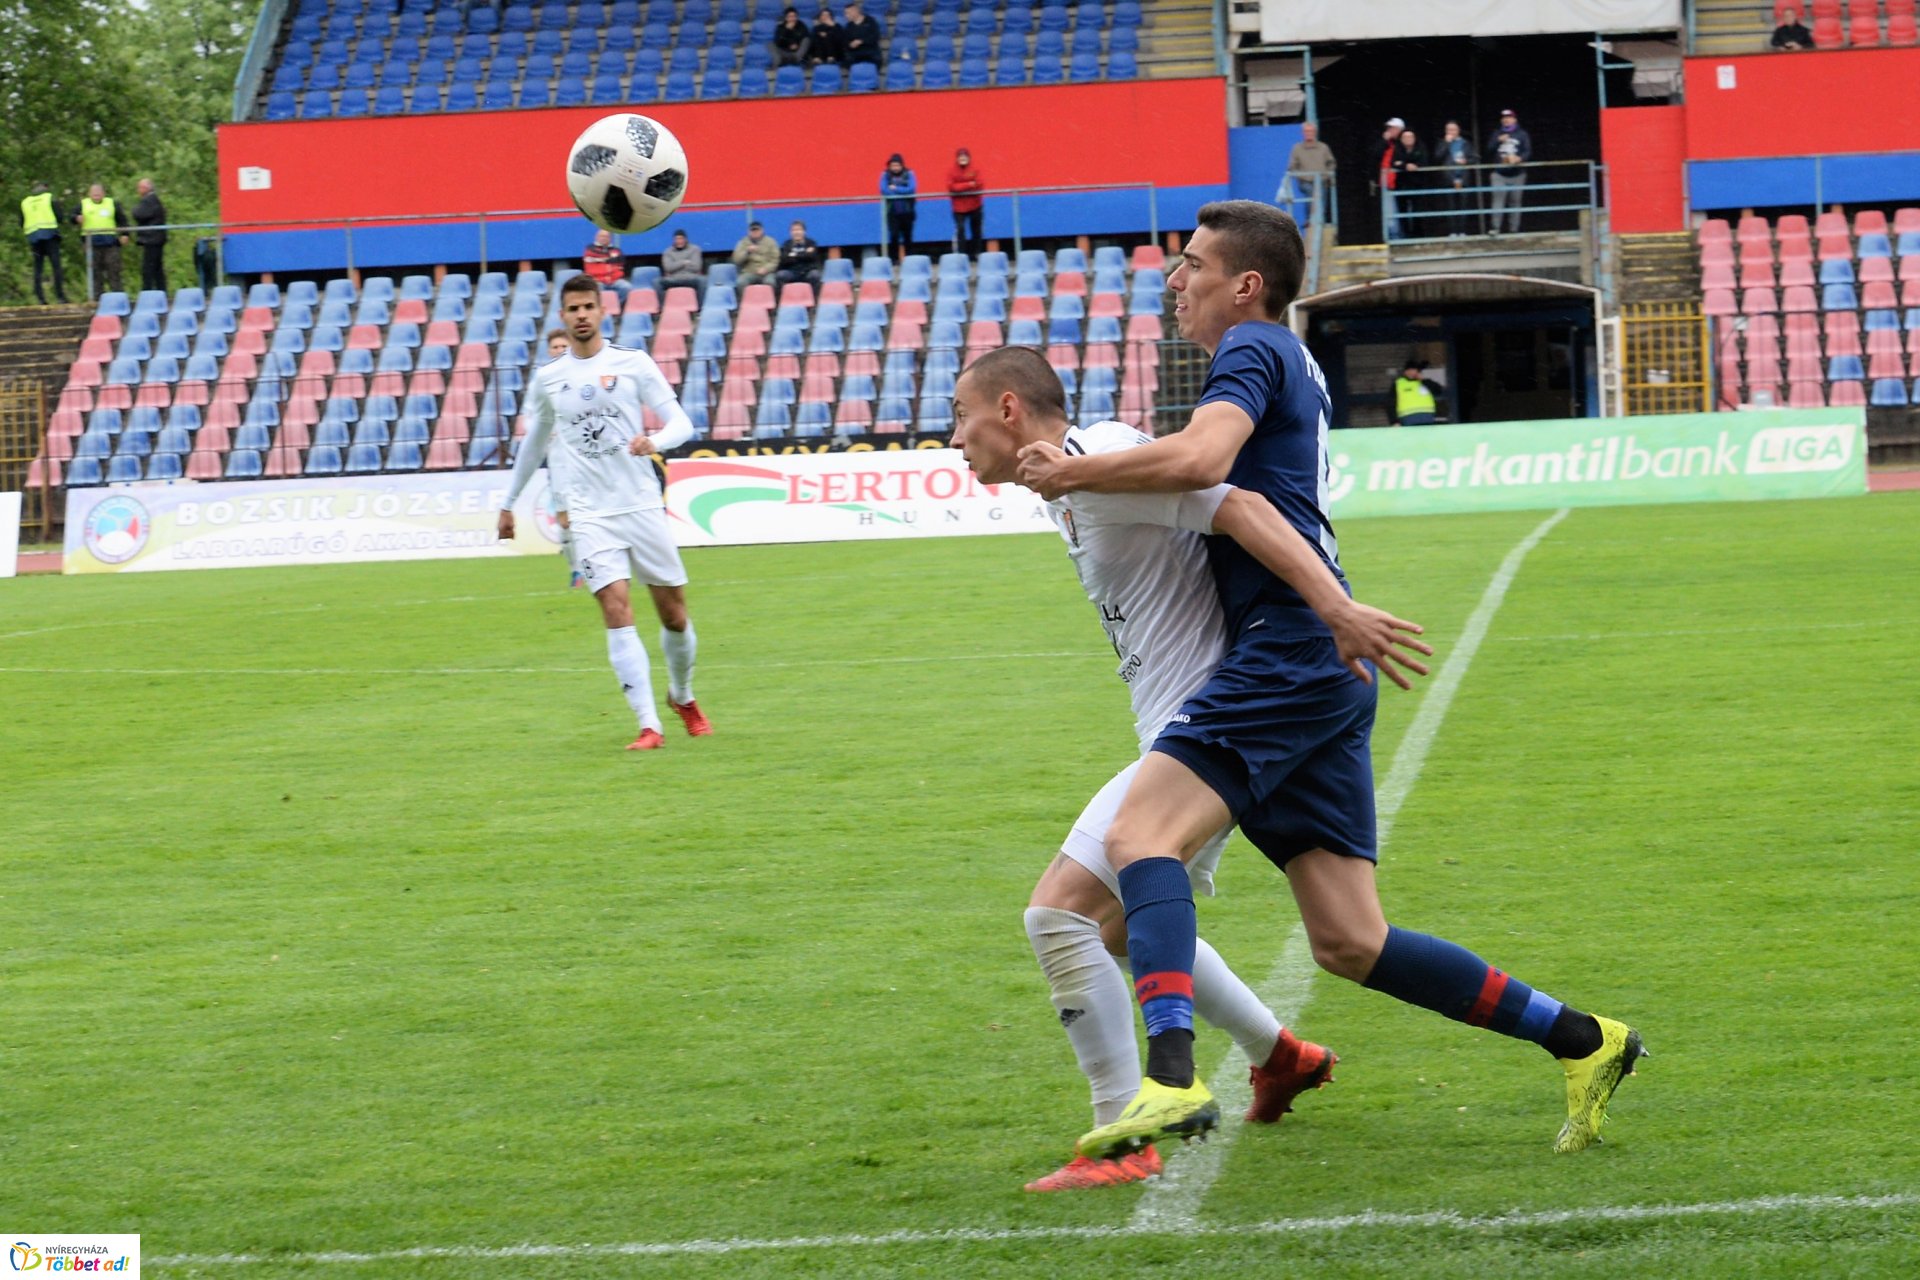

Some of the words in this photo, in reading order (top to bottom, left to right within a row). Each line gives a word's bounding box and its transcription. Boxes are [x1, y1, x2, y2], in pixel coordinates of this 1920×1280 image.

[1759, 435, 1844, 464] LIGA
[175, 496, 337, 526] BOZSIK
[347, 486, 509, 519] JÓZSEF
[859, 506, 1046, 525] HUNGA
[172, 529, 347, 560] LABDARÚGÓ
